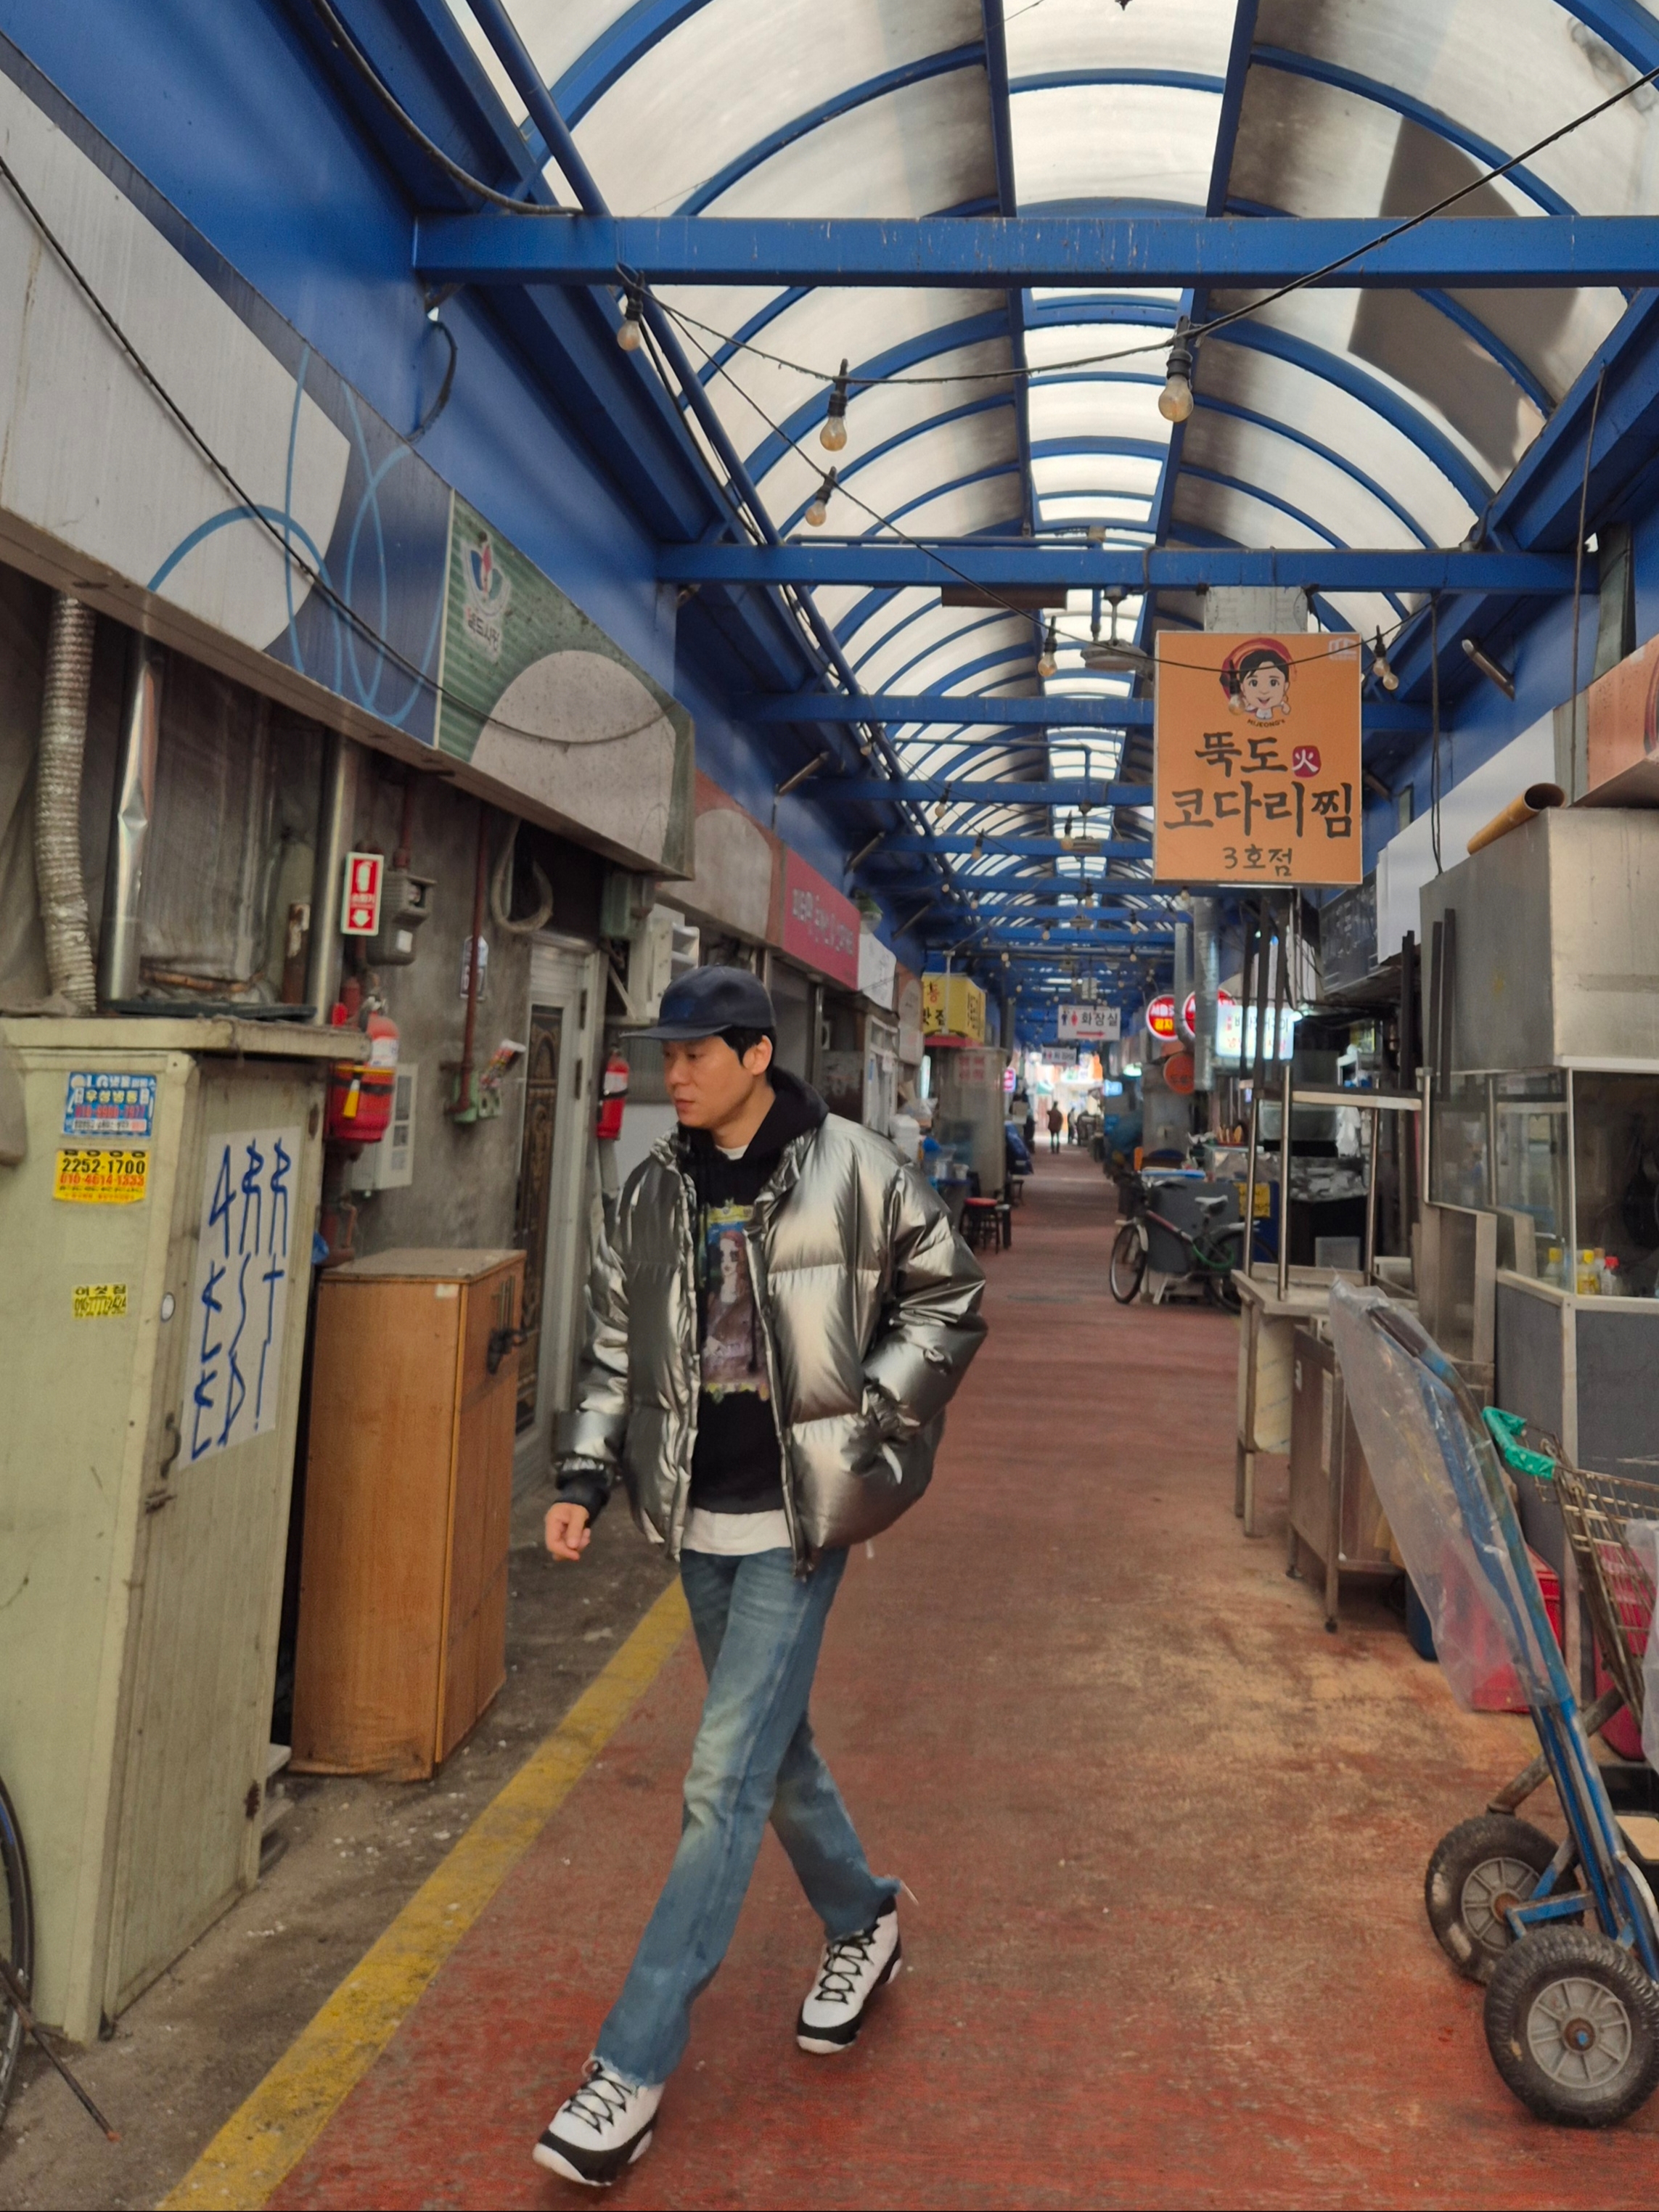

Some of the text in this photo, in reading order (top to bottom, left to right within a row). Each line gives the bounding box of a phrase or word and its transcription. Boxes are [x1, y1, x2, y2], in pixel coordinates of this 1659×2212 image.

[1195, 732, 1319, 778] 뚝도 火
[1163, 779, 1353, 839] 코다리찜
[1222, 844, 1293, 877] 3호점
[1081, 1011, 1119, 1028] 화장실
[62, 1158, 146, 1175] 2252-1700
